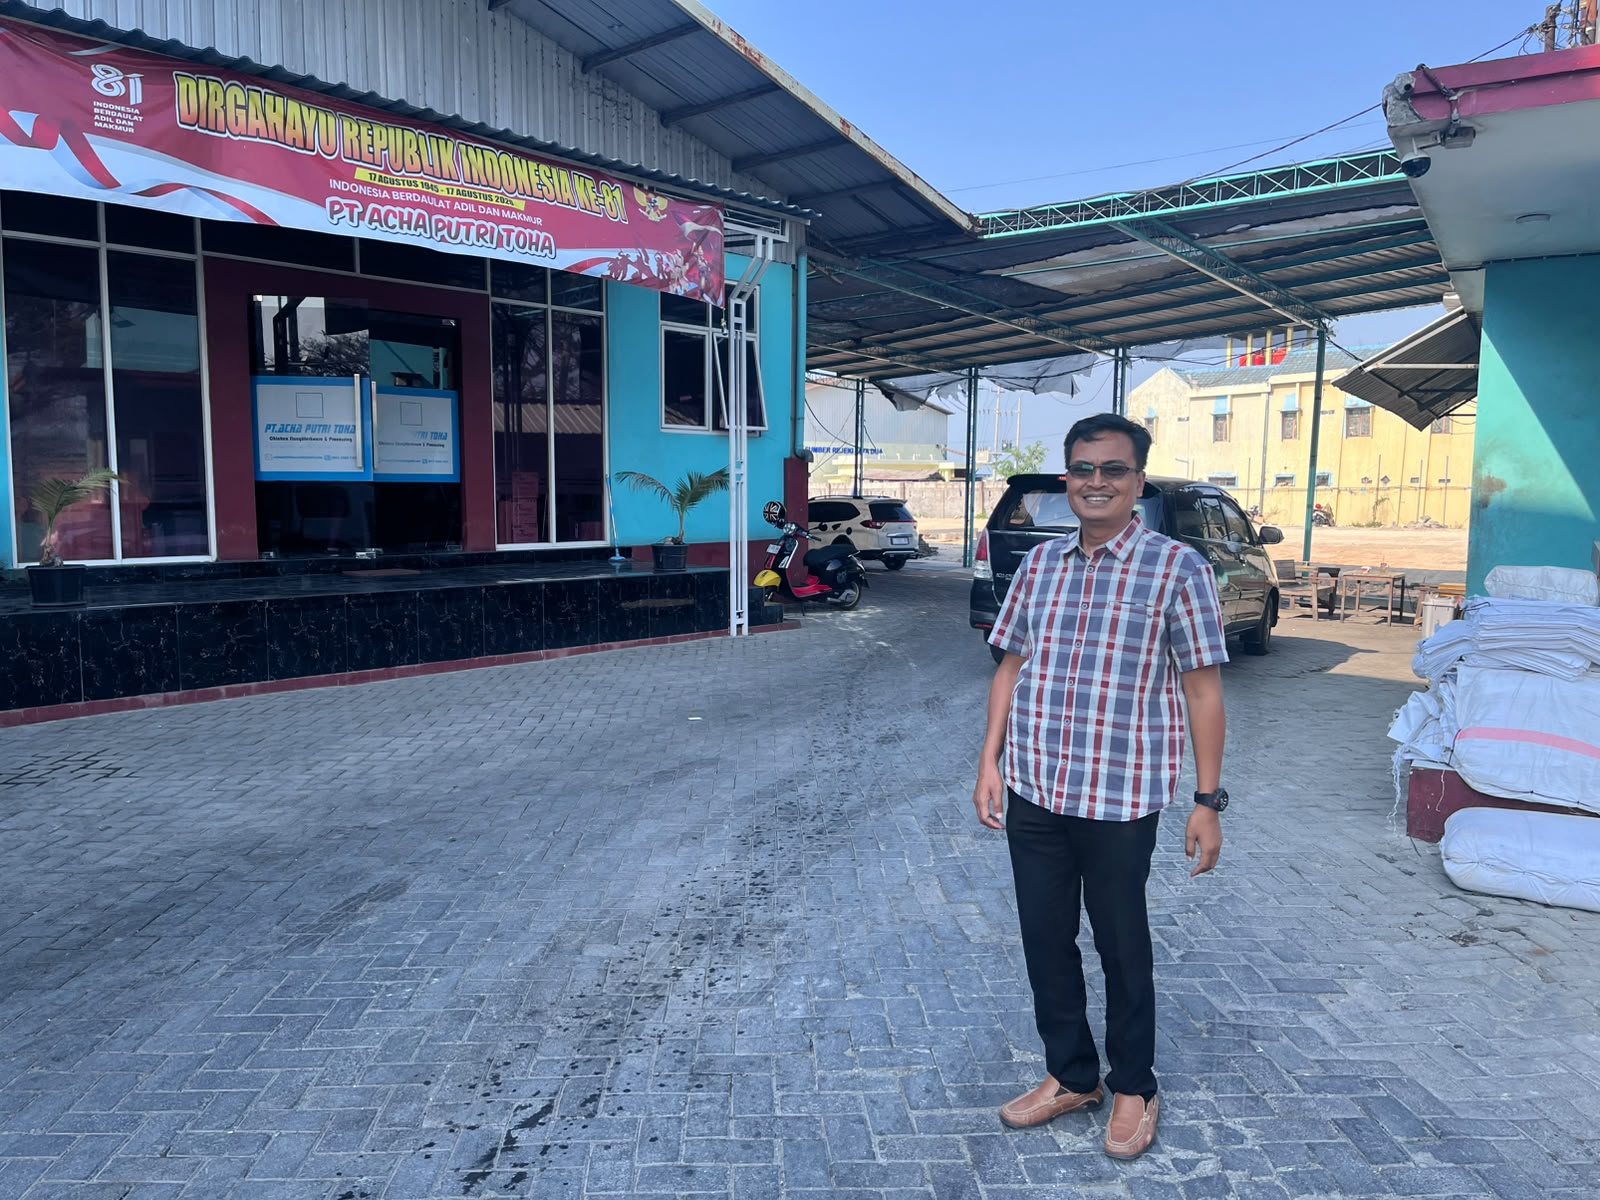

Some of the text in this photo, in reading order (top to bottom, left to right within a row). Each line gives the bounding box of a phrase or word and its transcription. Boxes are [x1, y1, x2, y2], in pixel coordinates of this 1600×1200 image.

[90, 64, 145, 105] 81
[93, 101, 140, 115] INDONESIA
[93, 108, 144, 122] BERDAULAT
[94, 115, 134, 127] ADIL DAN
[94, 122, 135, 133] MAKMUR
[173, 72, 628, 222] DIRGAHAYU REPUBLIK INDONESIA KE-81
[368, 172, 377, 181] 17
[377, 174, 419, 188] AGUSTUS
[420, 181, 440, 193] 1945
[446, 187, 455, 196] 17
[456, 190, 494, 202] AGUSTUS
[329, 179, 543, 226] INDONESIA BERDAULAT ADIL DAN MAKMUR
[327, 198, 555, 257] PT ACHA PUTRI TOHA
[304, 424, 332, 433] PUTRI
[333, 424, 356, 434] TOHA
